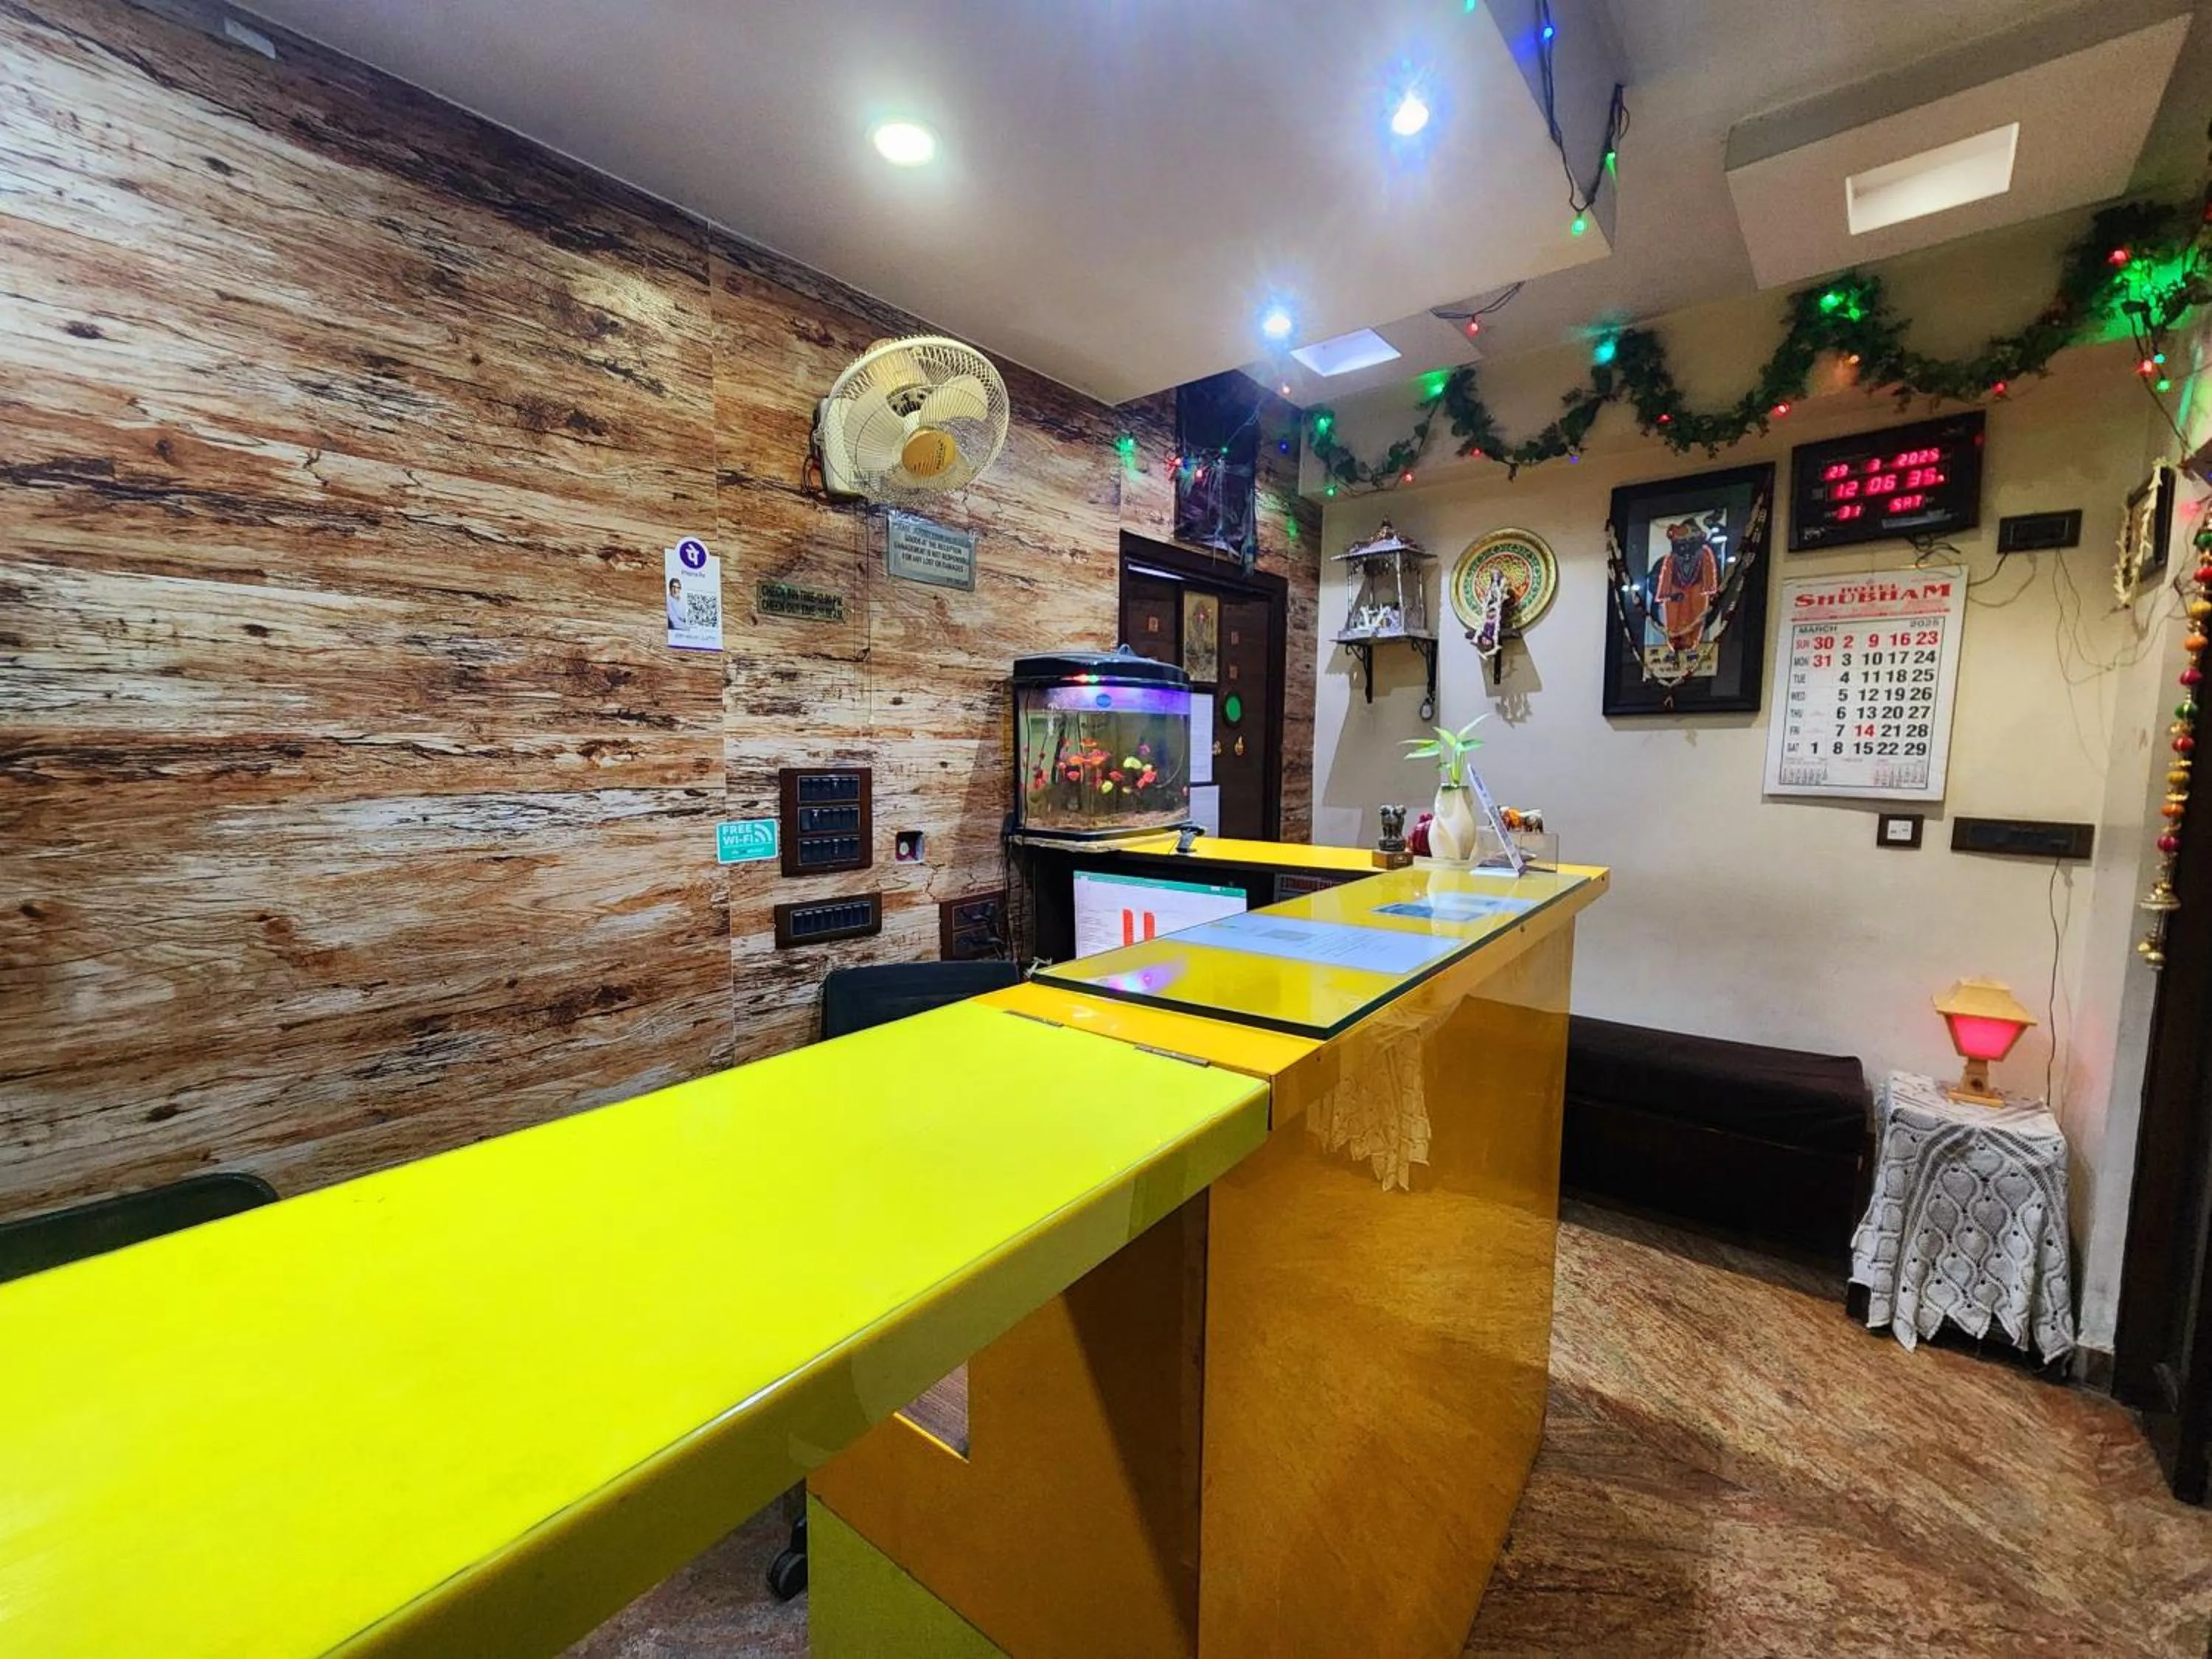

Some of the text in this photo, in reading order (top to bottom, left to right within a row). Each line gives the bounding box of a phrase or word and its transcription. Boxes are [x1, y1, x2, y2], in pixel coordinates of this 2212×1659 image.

[1826, 448, 1940, 479] 29 3 2025
[1836, 480, 1859, 498] 12
[1868, 473, 1896, 494] 06
[1891, 494, 1923, 510] SAT
[1798, 625, 1837, 633] MARCH
[1813, 636, 1835, 650] 30
[1843, 635, 1854, 649] 2
[1868, 633, 1879, 647] 9
[1890, 633, 1910, 646] 16
[1916, 630, 1938, 644] 23
[1812, 654, 1832, 667] 31
[1841, 653, 1852, 667] 3
[1862, 651, 1883, 666] 10
[1888, 651, 1910, 664] 17
[1913, 650, 1936, 664] 24
[1839, 671, 1850, 684] 4
[1861, 670, 1880, 683] 11
[1886, 669, 1907, 683] 18
[1911, 668, 1934, 682] 25
[1837, 688, 1848, 701] 5
[1858, 688, 1879, 701] 12
[1884, 687, 1905, 701] 19
[1910, 686, 1933, 700] 26
[1836, 706, 1846, 720] 6
[1856, 706, 1877, 720] 13
[1881, 706, 1904, 720] 20
[1907, 706, 1931, 719] 27
[1835, 724, 1846, 737] 7
[1854, 724, 1874, 737] 14
[1881, 724, 1901, 737] 21
[1906, 724, 1928, 737] 28
[1811, 742, 1818, 754] 1
[1832, 742, 1843, 755] 8
[1854, 742, 1874, 755] 15
[1877, 742, 1899, 756] 22
[1904, 742, 1927, 756] 29
[722, 824, 753, 835] FREE
